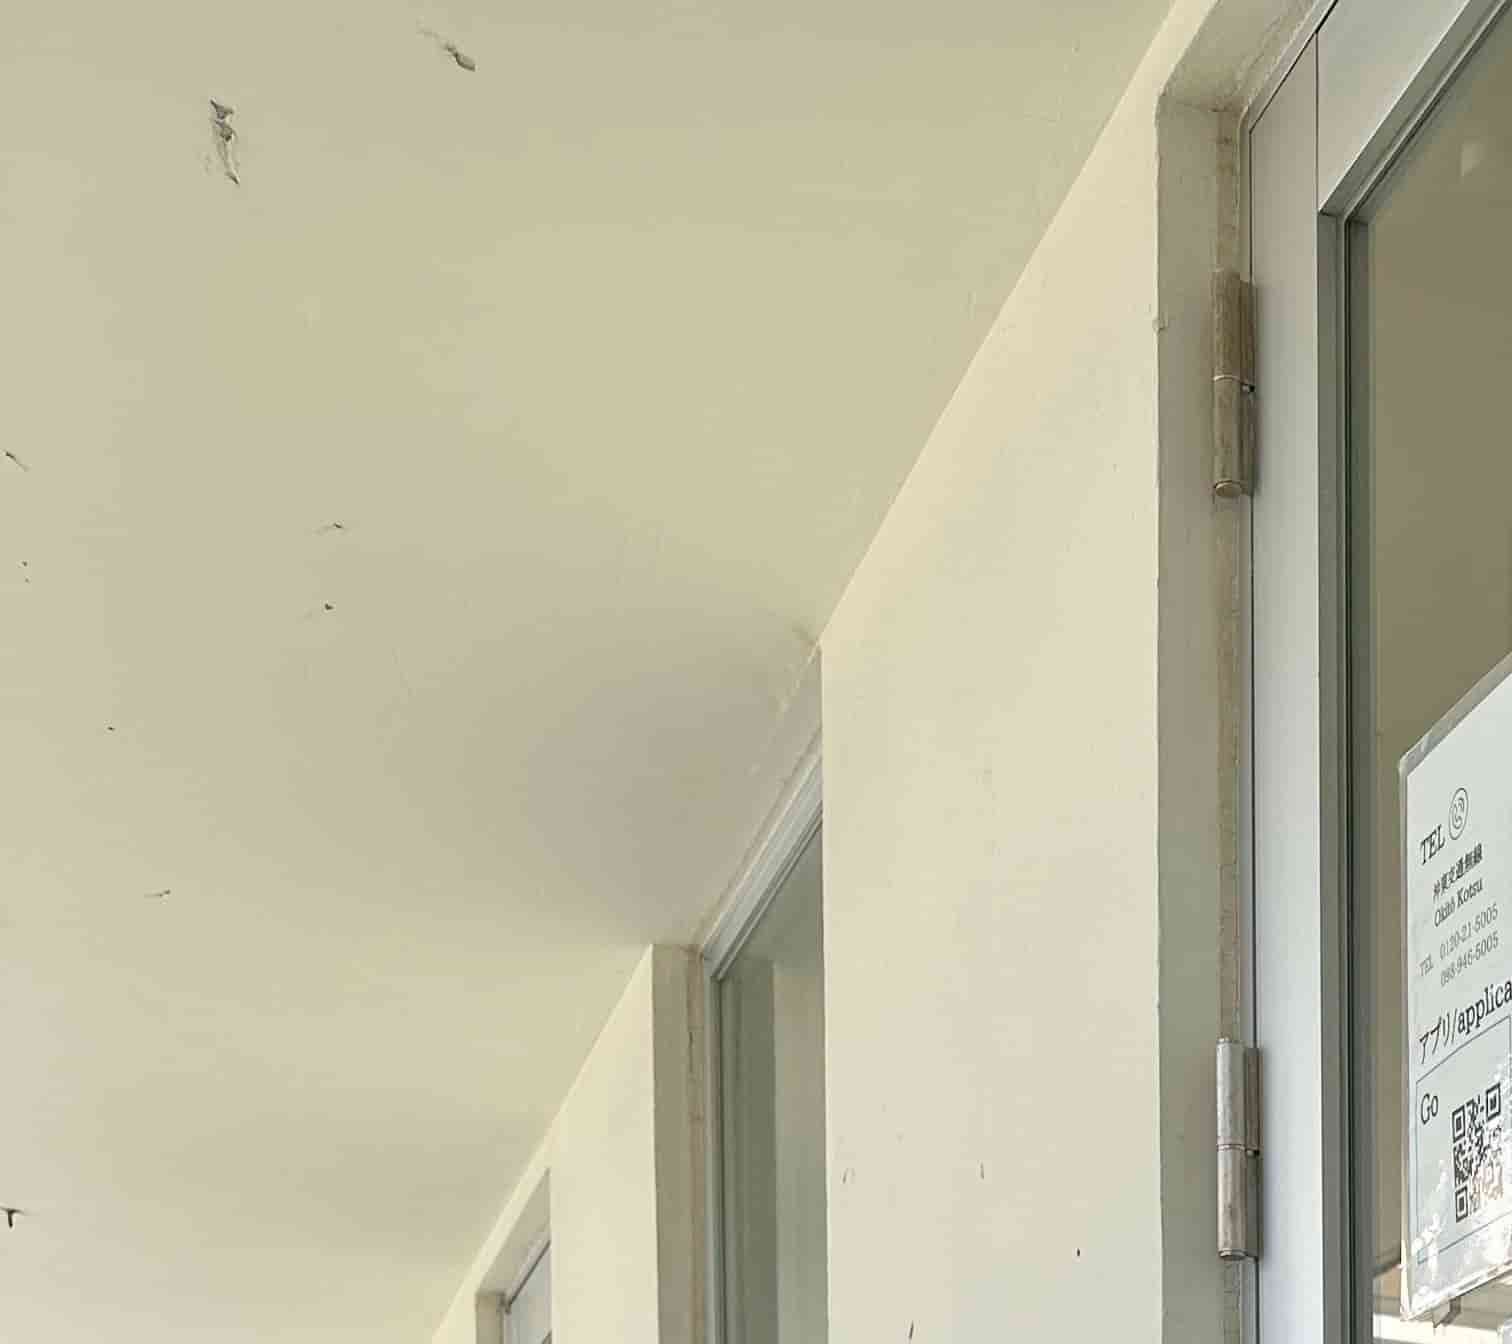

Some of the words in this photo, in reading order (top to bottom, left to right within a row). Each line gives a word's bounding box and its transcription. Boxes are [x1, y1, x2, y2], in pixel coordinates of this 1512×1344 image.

[1420, 824, 1446, 866] TEL
[1457, 877, 1484, 909] Kotsu
[1420, 1093, 1439, 1125] Go
